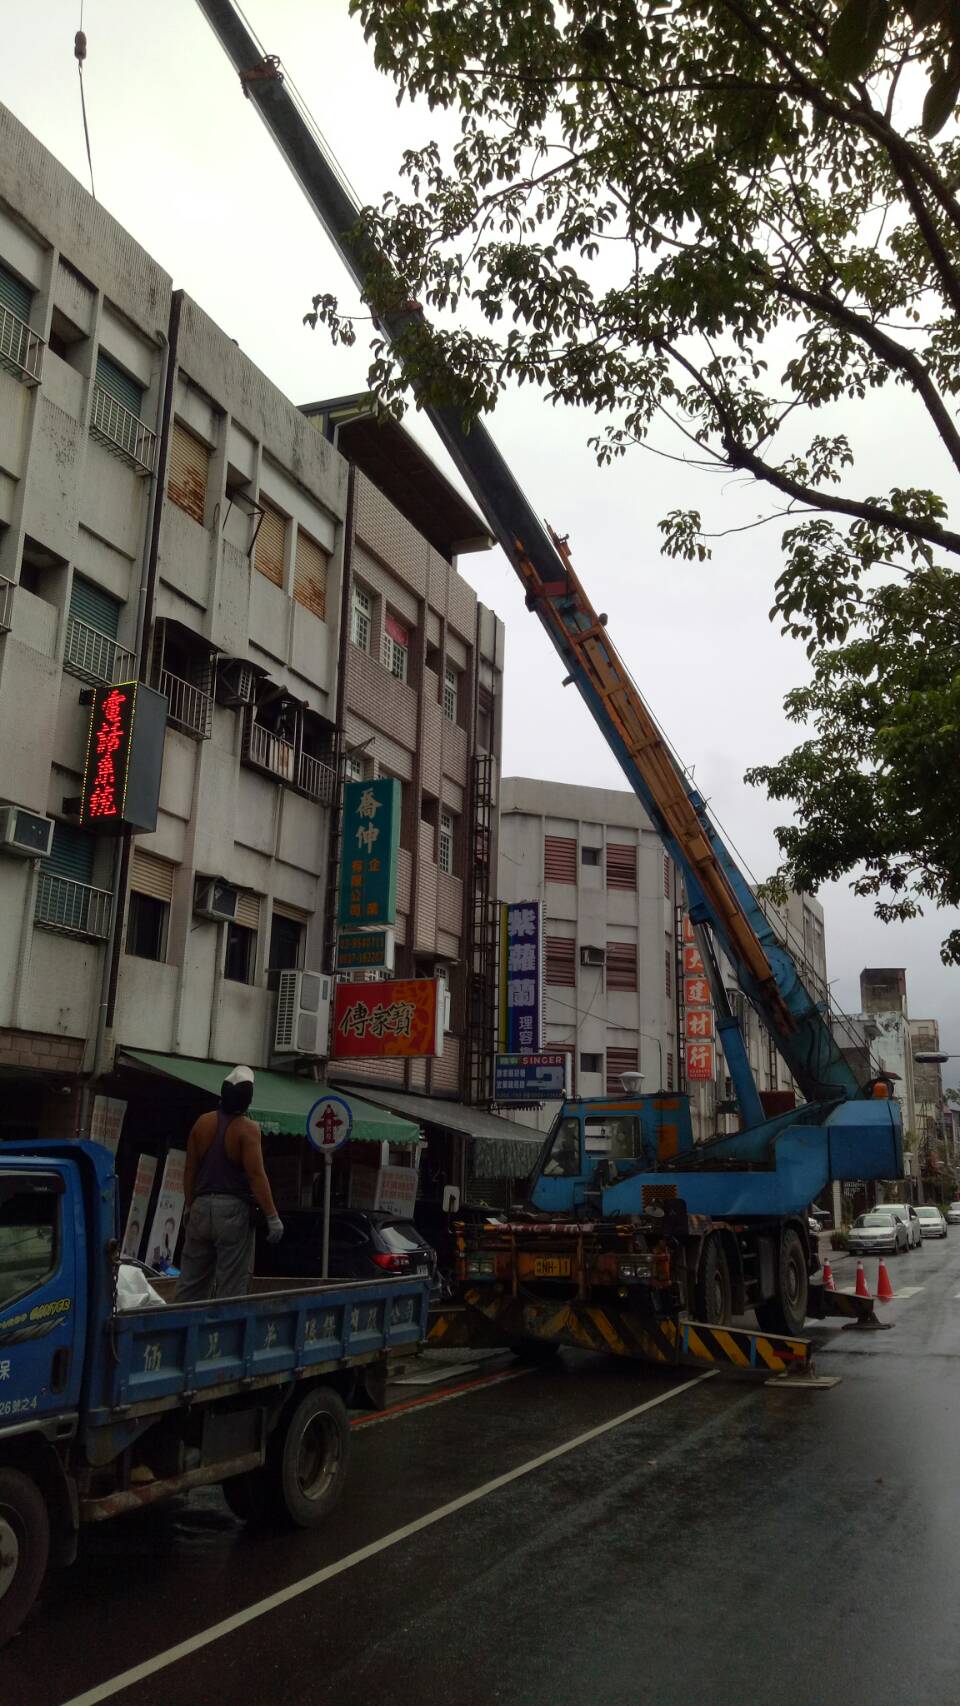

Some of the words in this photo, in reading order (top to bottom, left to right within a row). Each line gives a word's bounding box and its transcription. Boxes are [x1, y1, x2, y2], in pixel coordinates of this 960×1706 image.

[338, 1001, 416, 1038] 傳家寶
[522, 1056, 562, 1065] SINGER
